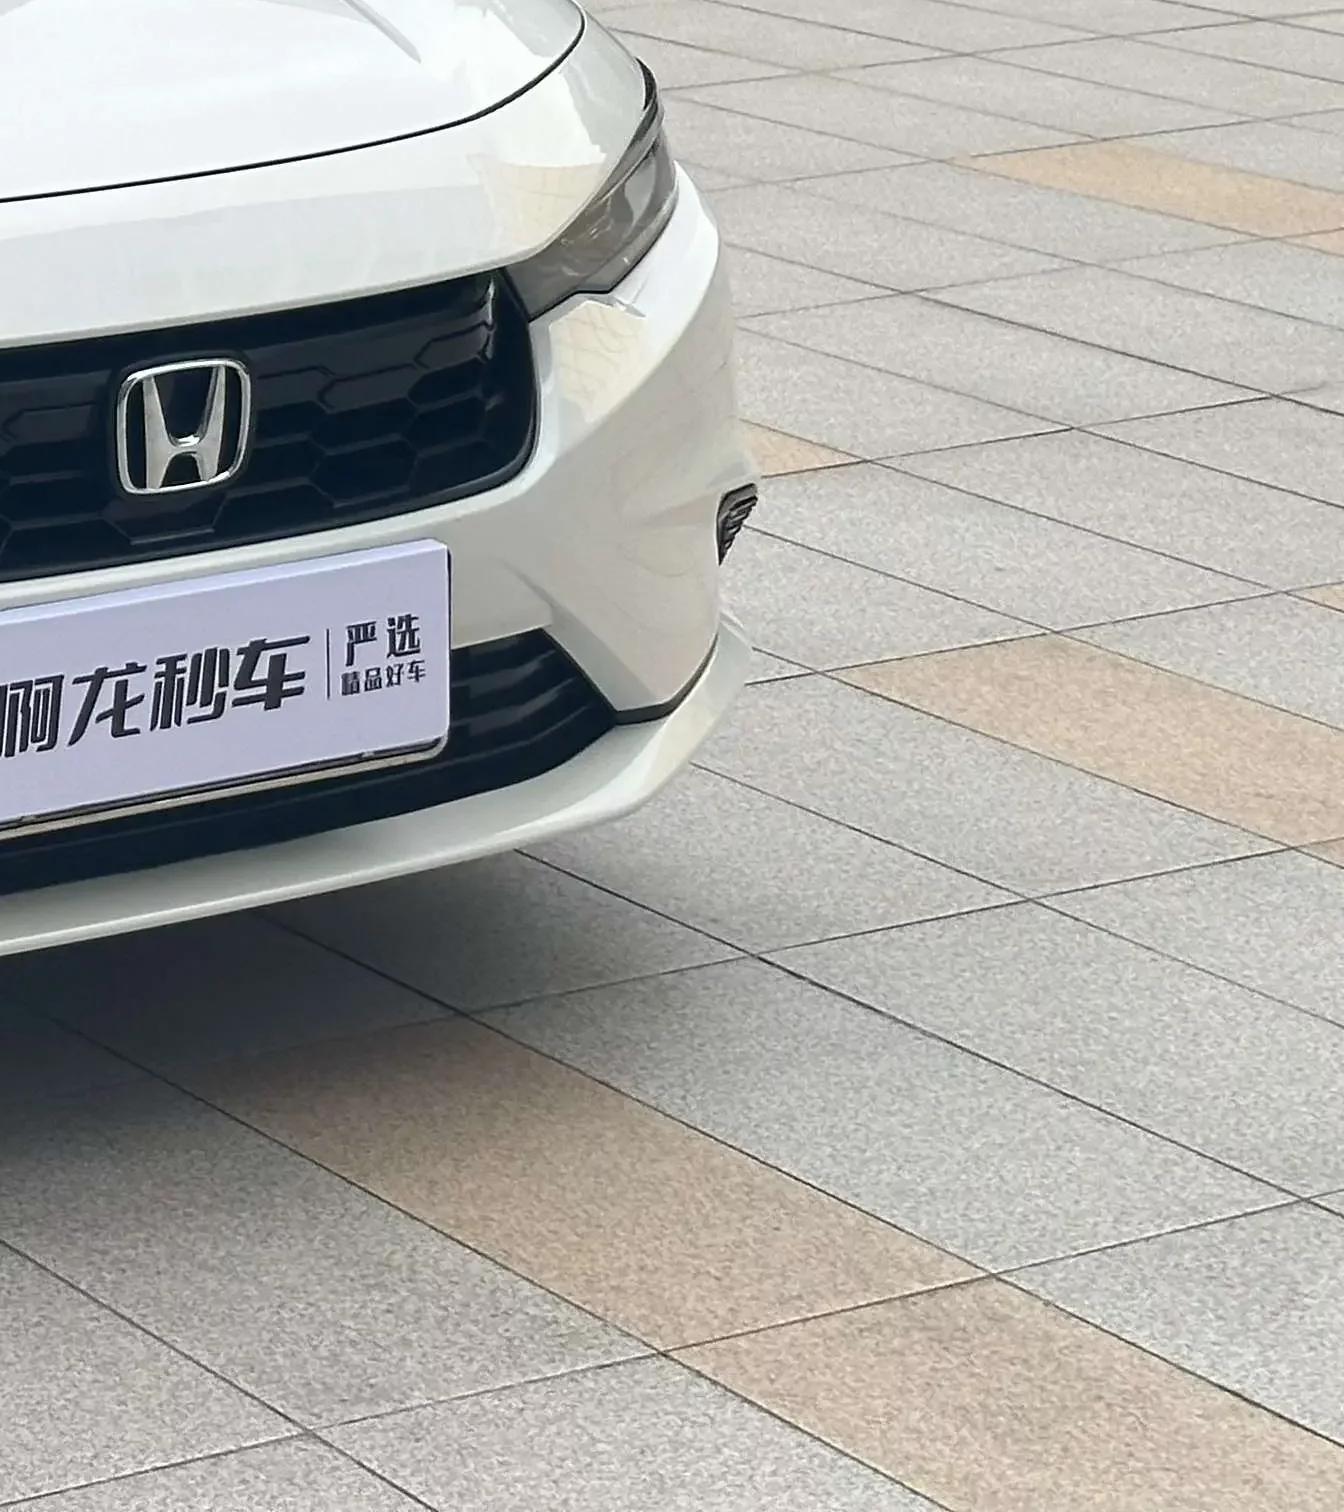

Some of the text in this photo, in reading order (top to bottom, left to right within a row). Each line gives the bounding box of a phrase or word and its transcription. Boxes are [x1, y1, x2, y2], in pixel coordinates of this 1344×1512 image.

[345, 613, 421, 667] 严选
[340, 659, 427, 696] 精品好车
